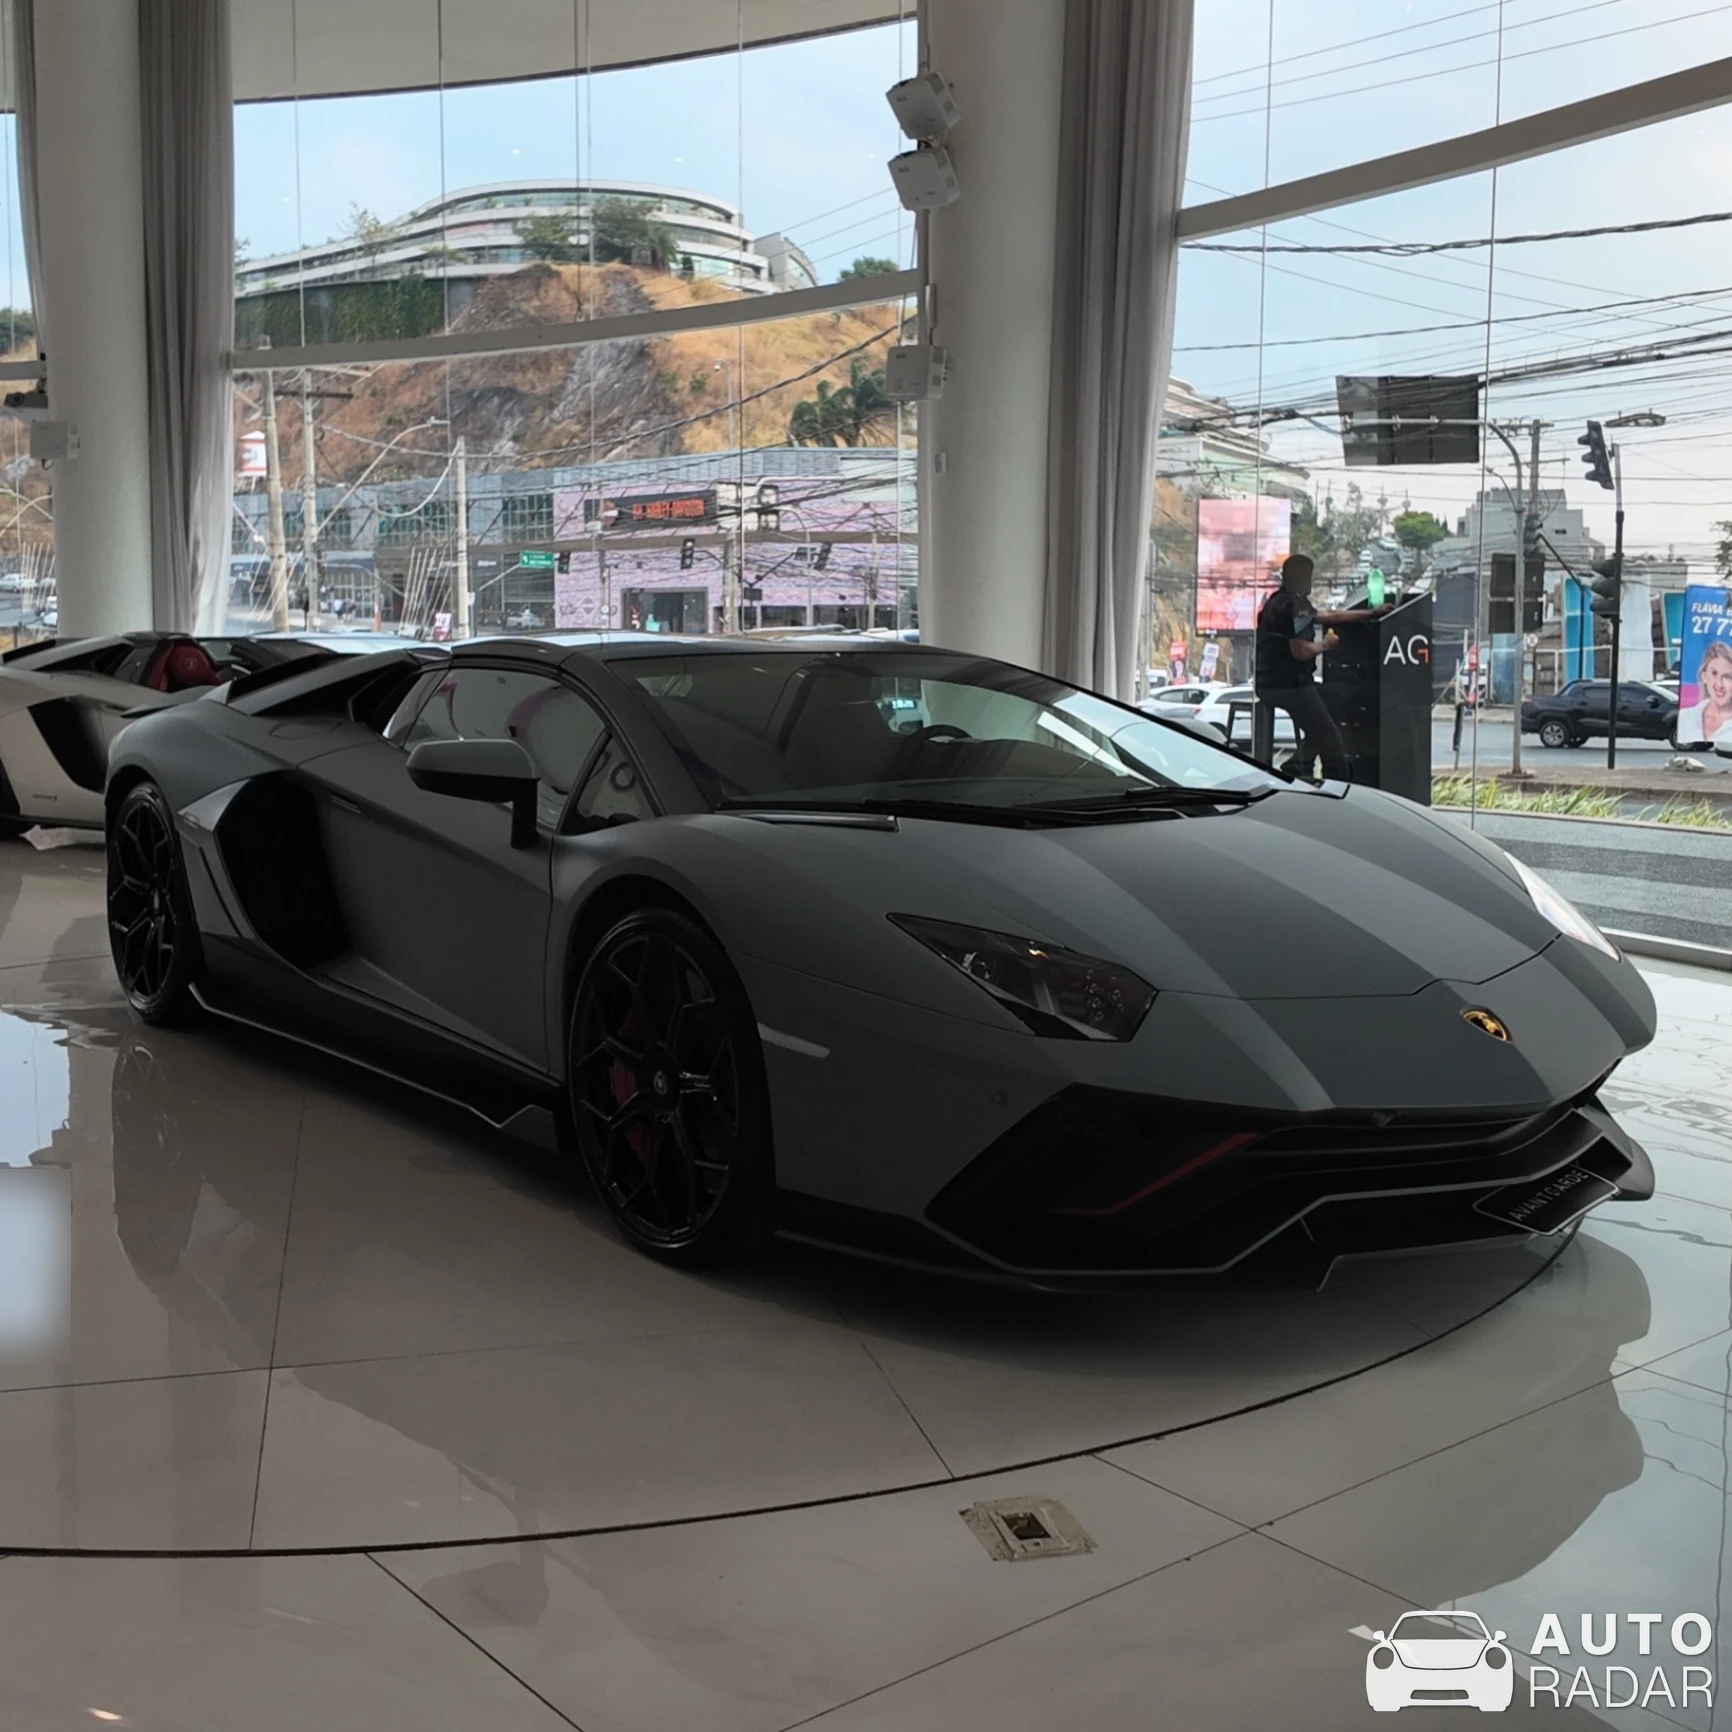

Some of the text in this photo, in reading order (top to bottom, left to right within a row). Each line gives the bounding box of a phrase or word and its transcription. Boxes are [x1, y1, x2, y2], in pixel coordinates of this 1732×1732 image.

[1692, 602, 1723, 615] FLÁVIA
[1692, 616, 1712, 634] 27
[1383, 634, 1429, 665] AG
